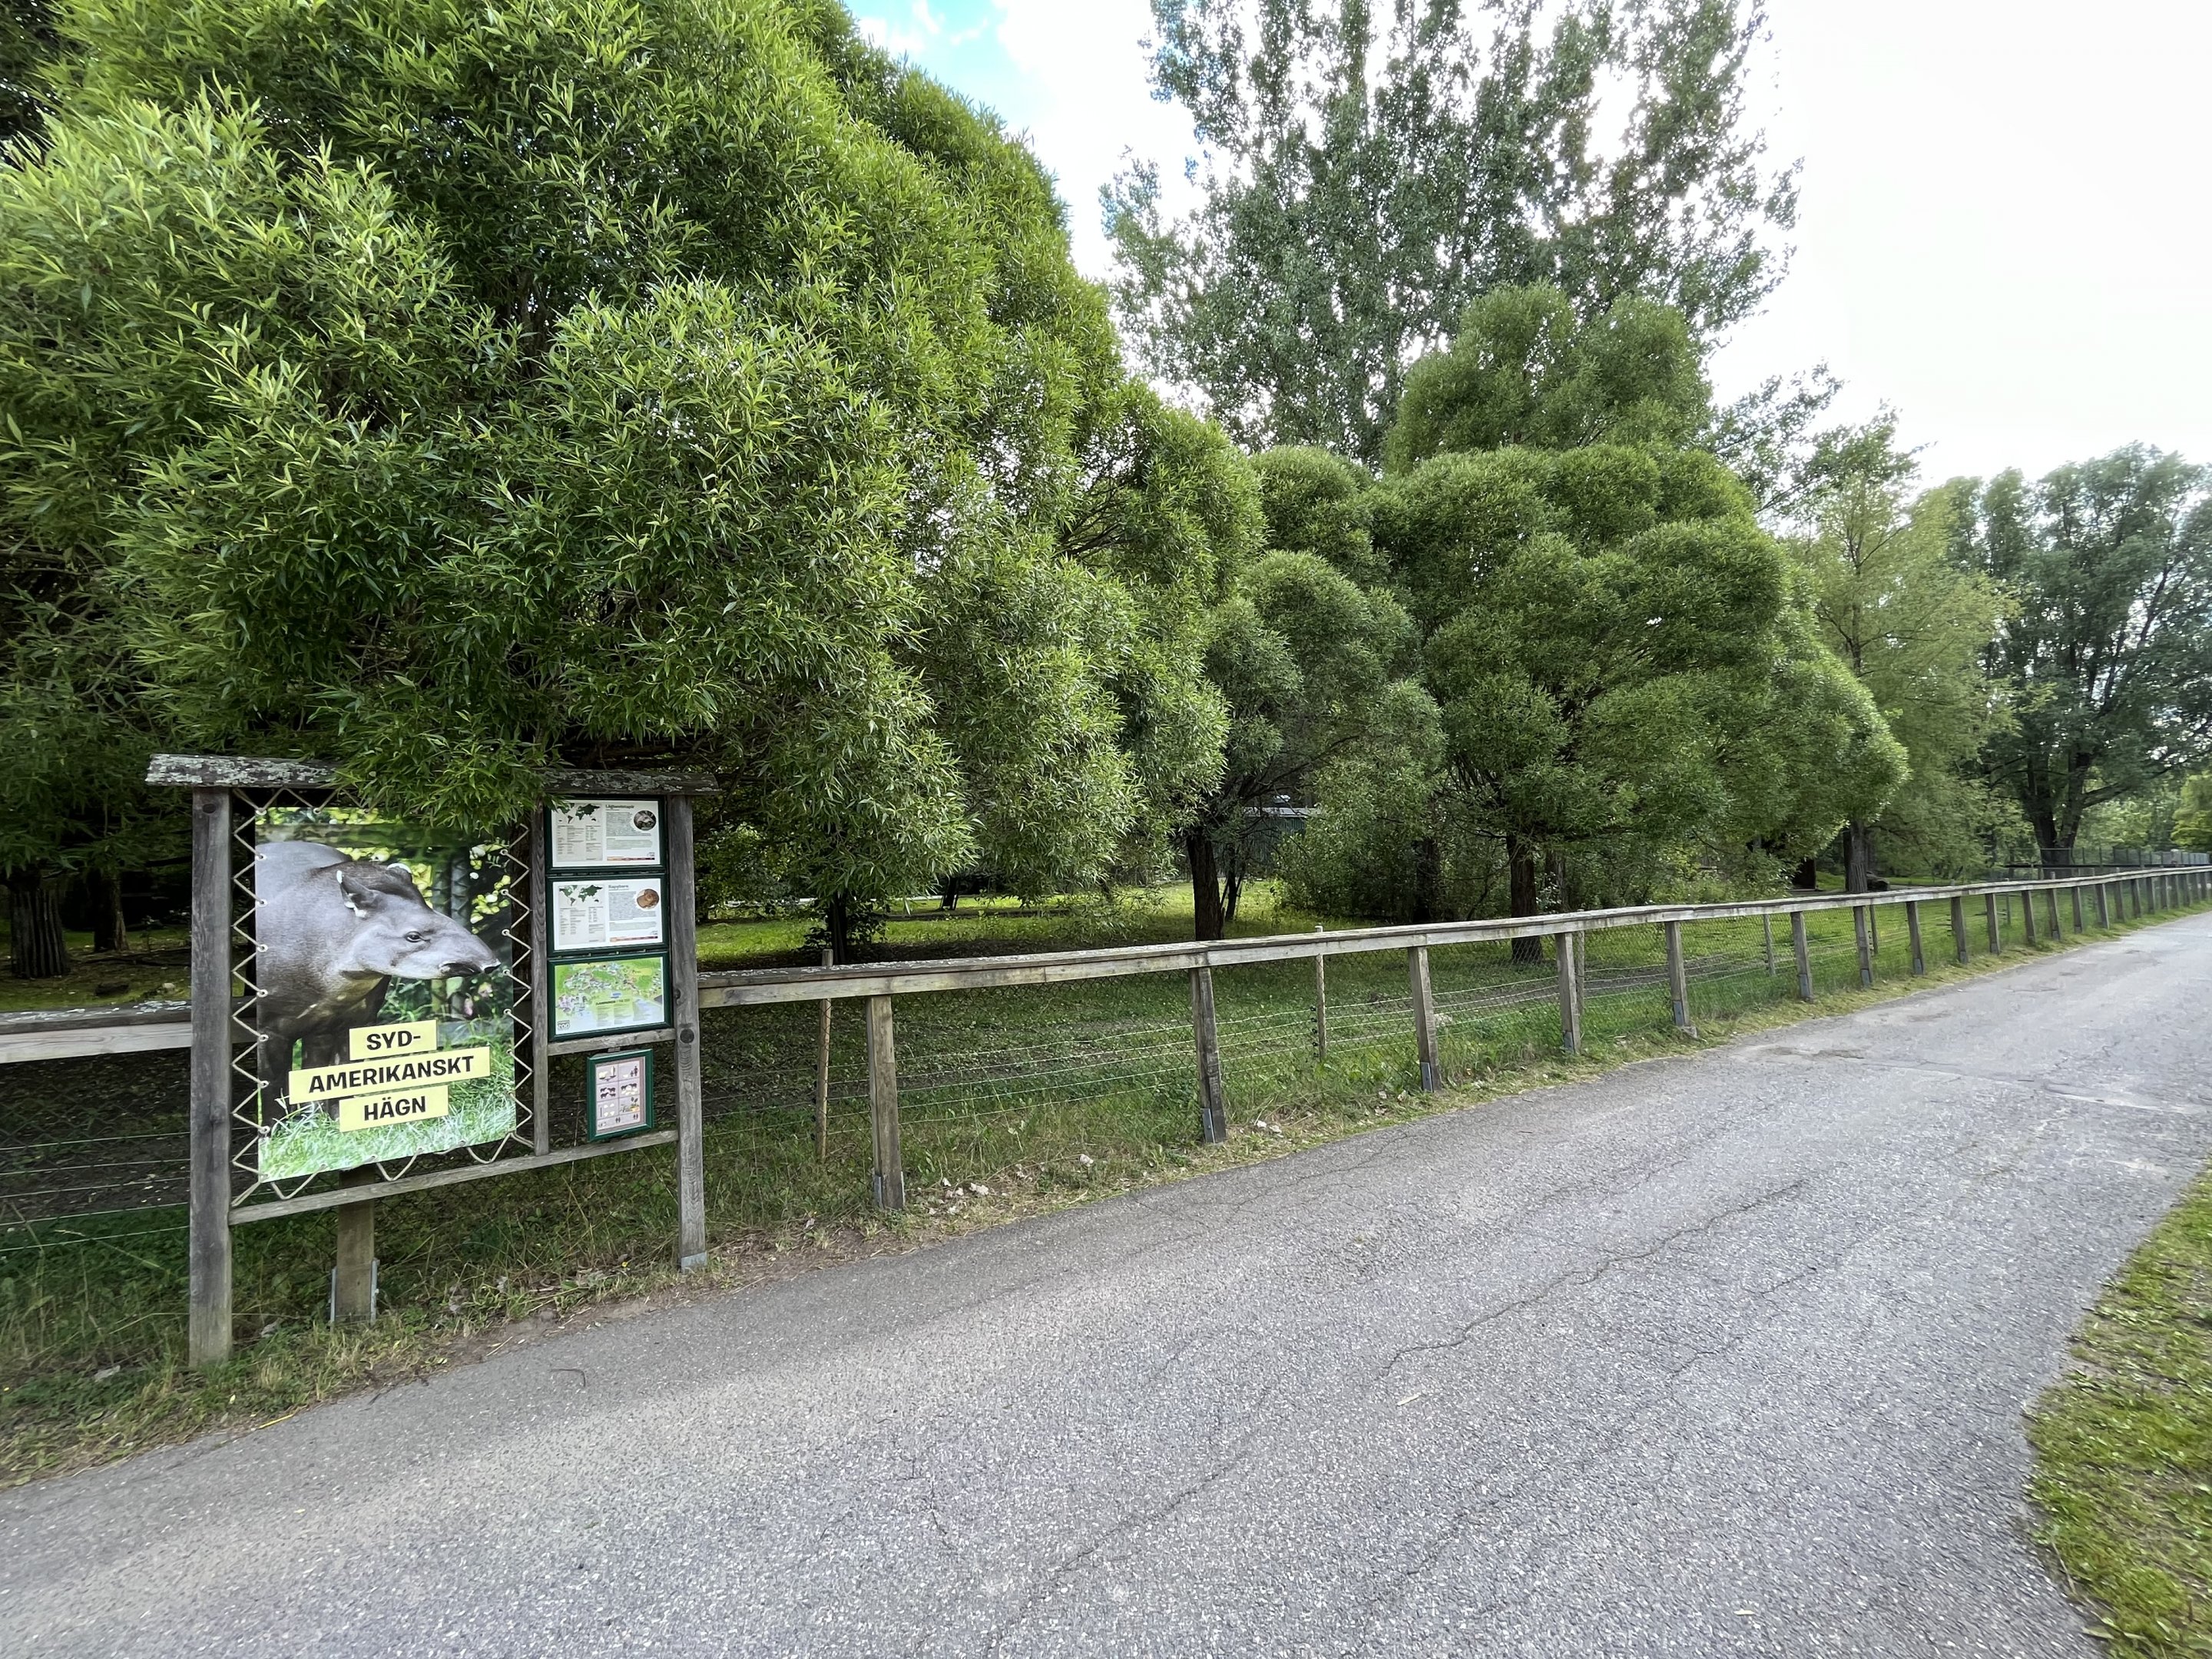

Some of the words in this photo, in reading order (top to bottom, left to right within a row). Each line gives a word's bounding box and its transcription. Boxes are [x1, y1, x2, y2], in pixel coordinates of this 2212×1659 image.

[366, 1030, 421, 1050] SYD-
[309, 1055, 474, 1093] AMERIKANSKT
[363, 1096, 426, 1121] HÄGN
